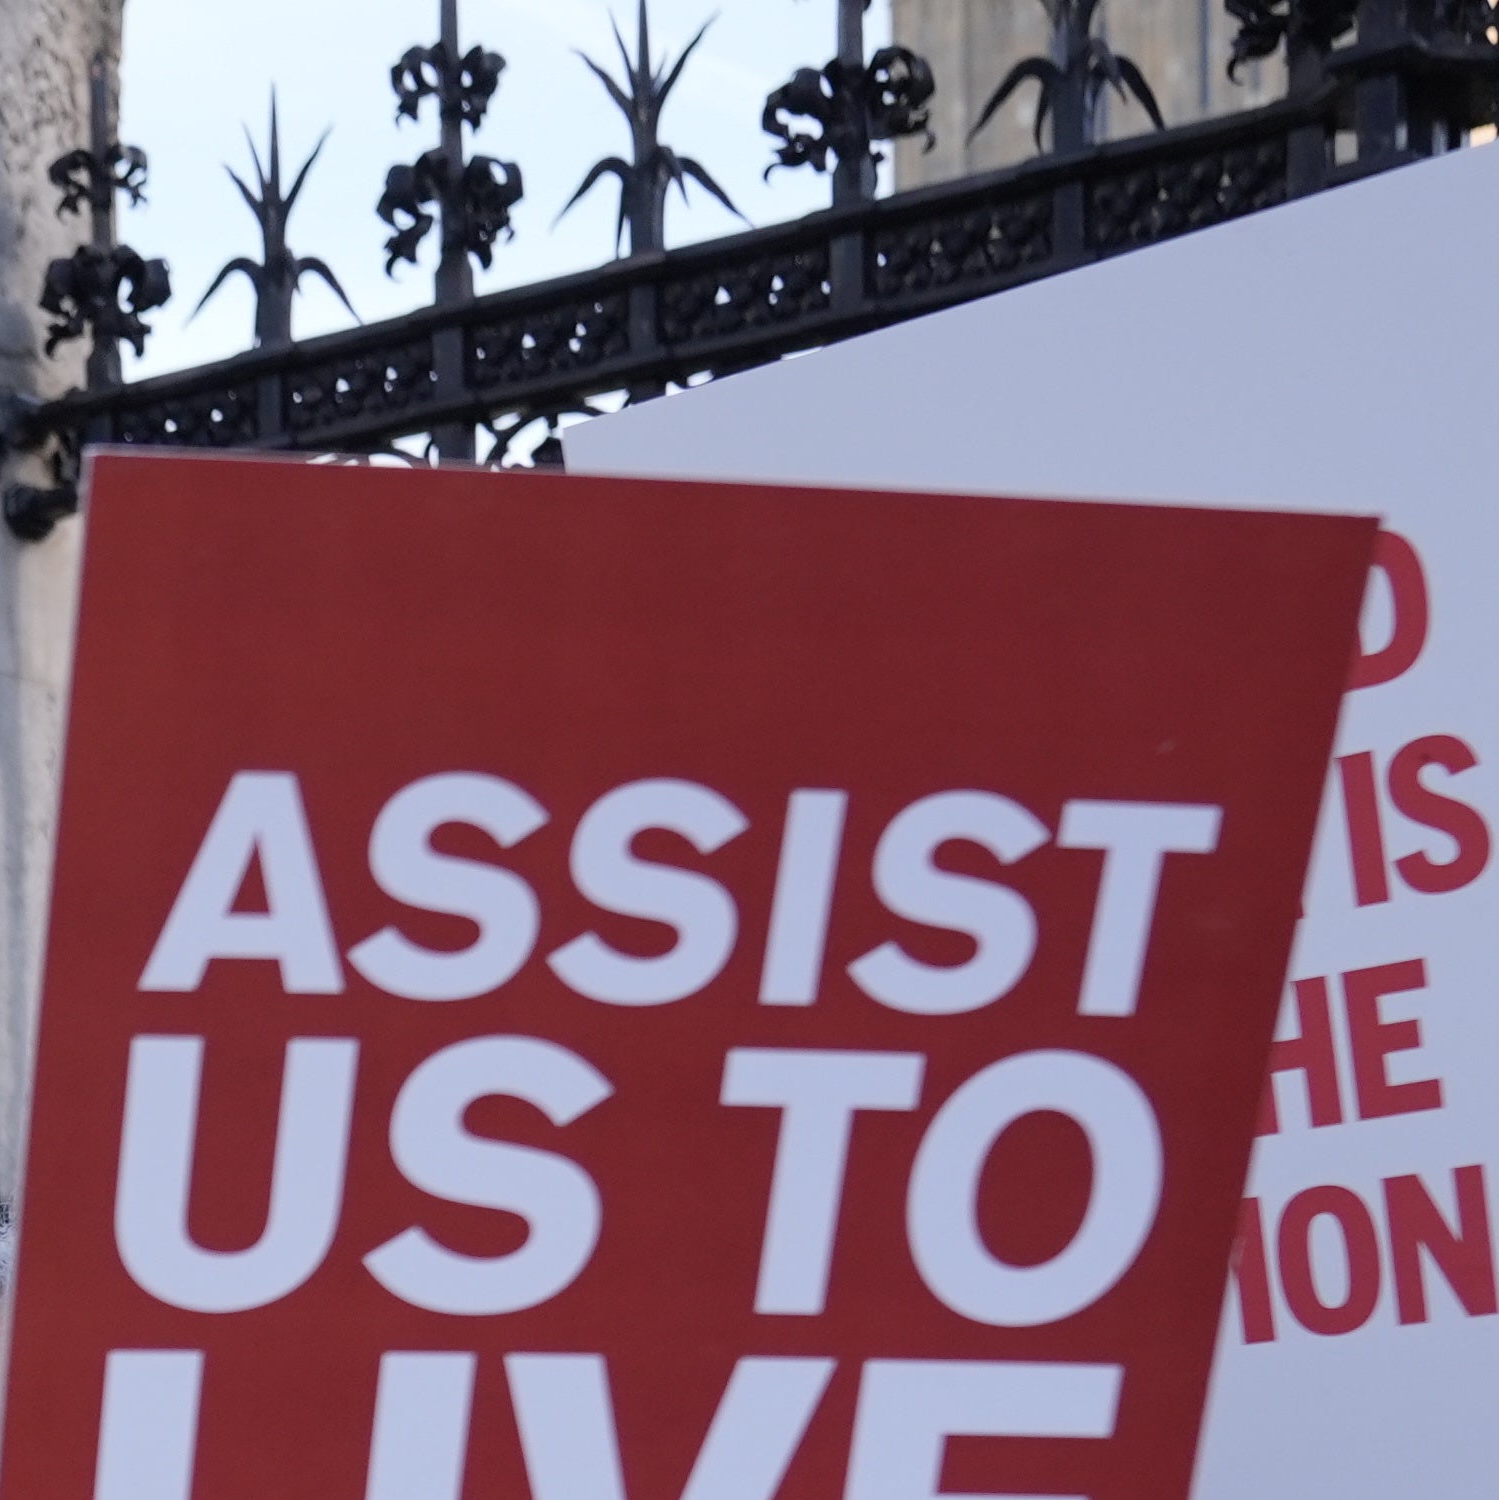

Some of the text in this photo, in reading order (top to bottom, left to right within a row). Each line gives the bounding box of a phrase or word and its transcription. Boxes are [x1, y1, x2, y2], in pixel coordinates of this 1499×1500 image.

[137, 771, 1222, 1017] ASSIST
[1337, 734, 1492, 908] IS
[114, 1034, 1163, 1328] US TO
